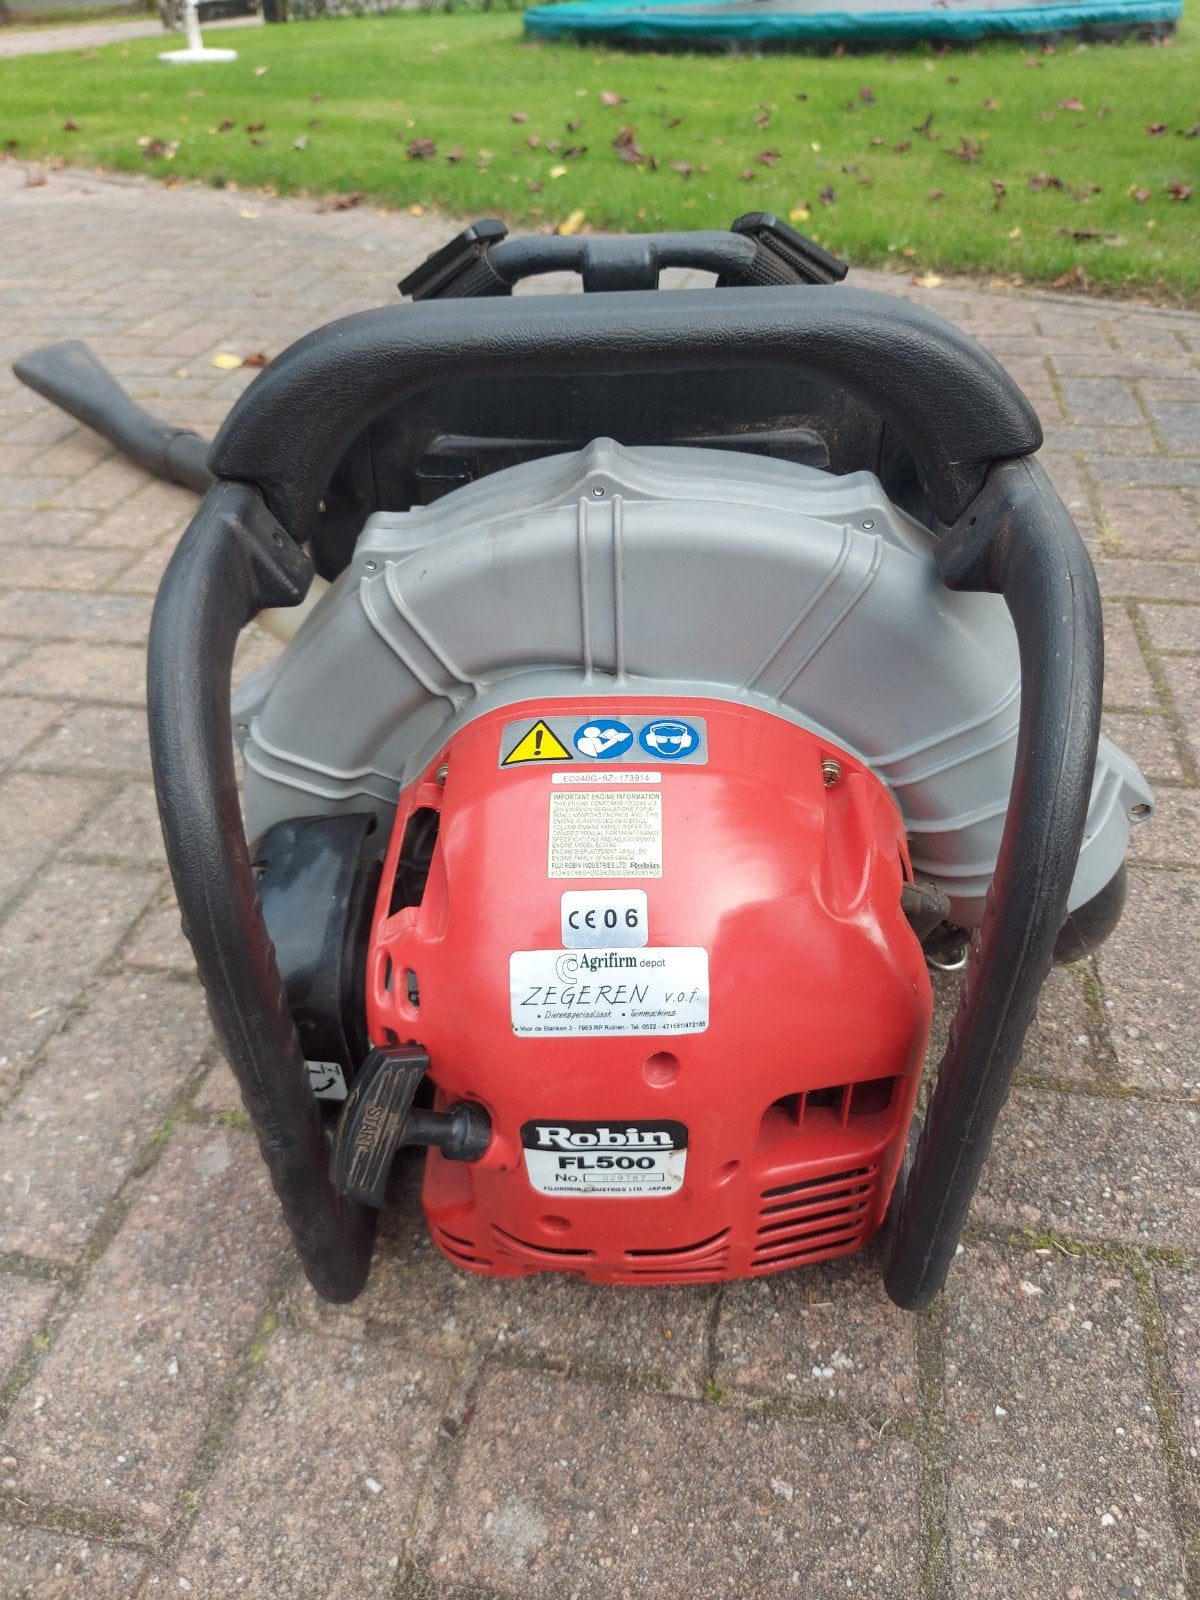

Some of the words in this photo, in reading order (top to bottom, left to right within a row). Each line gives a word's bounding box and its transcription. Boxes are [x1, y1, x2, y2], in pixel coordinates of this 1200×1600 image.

[580, 952, 637, 972] Agrifirm
[640, 958, 666, 968] depot
[520, 984, 649, 1009] ZEGEREN
[357, 1107, 383, 1150] START
[536, 1126, 674, 1150] Robin
[558, 1156, 655, 1169] FL500
[556, 1174, 582, 1182] No.
